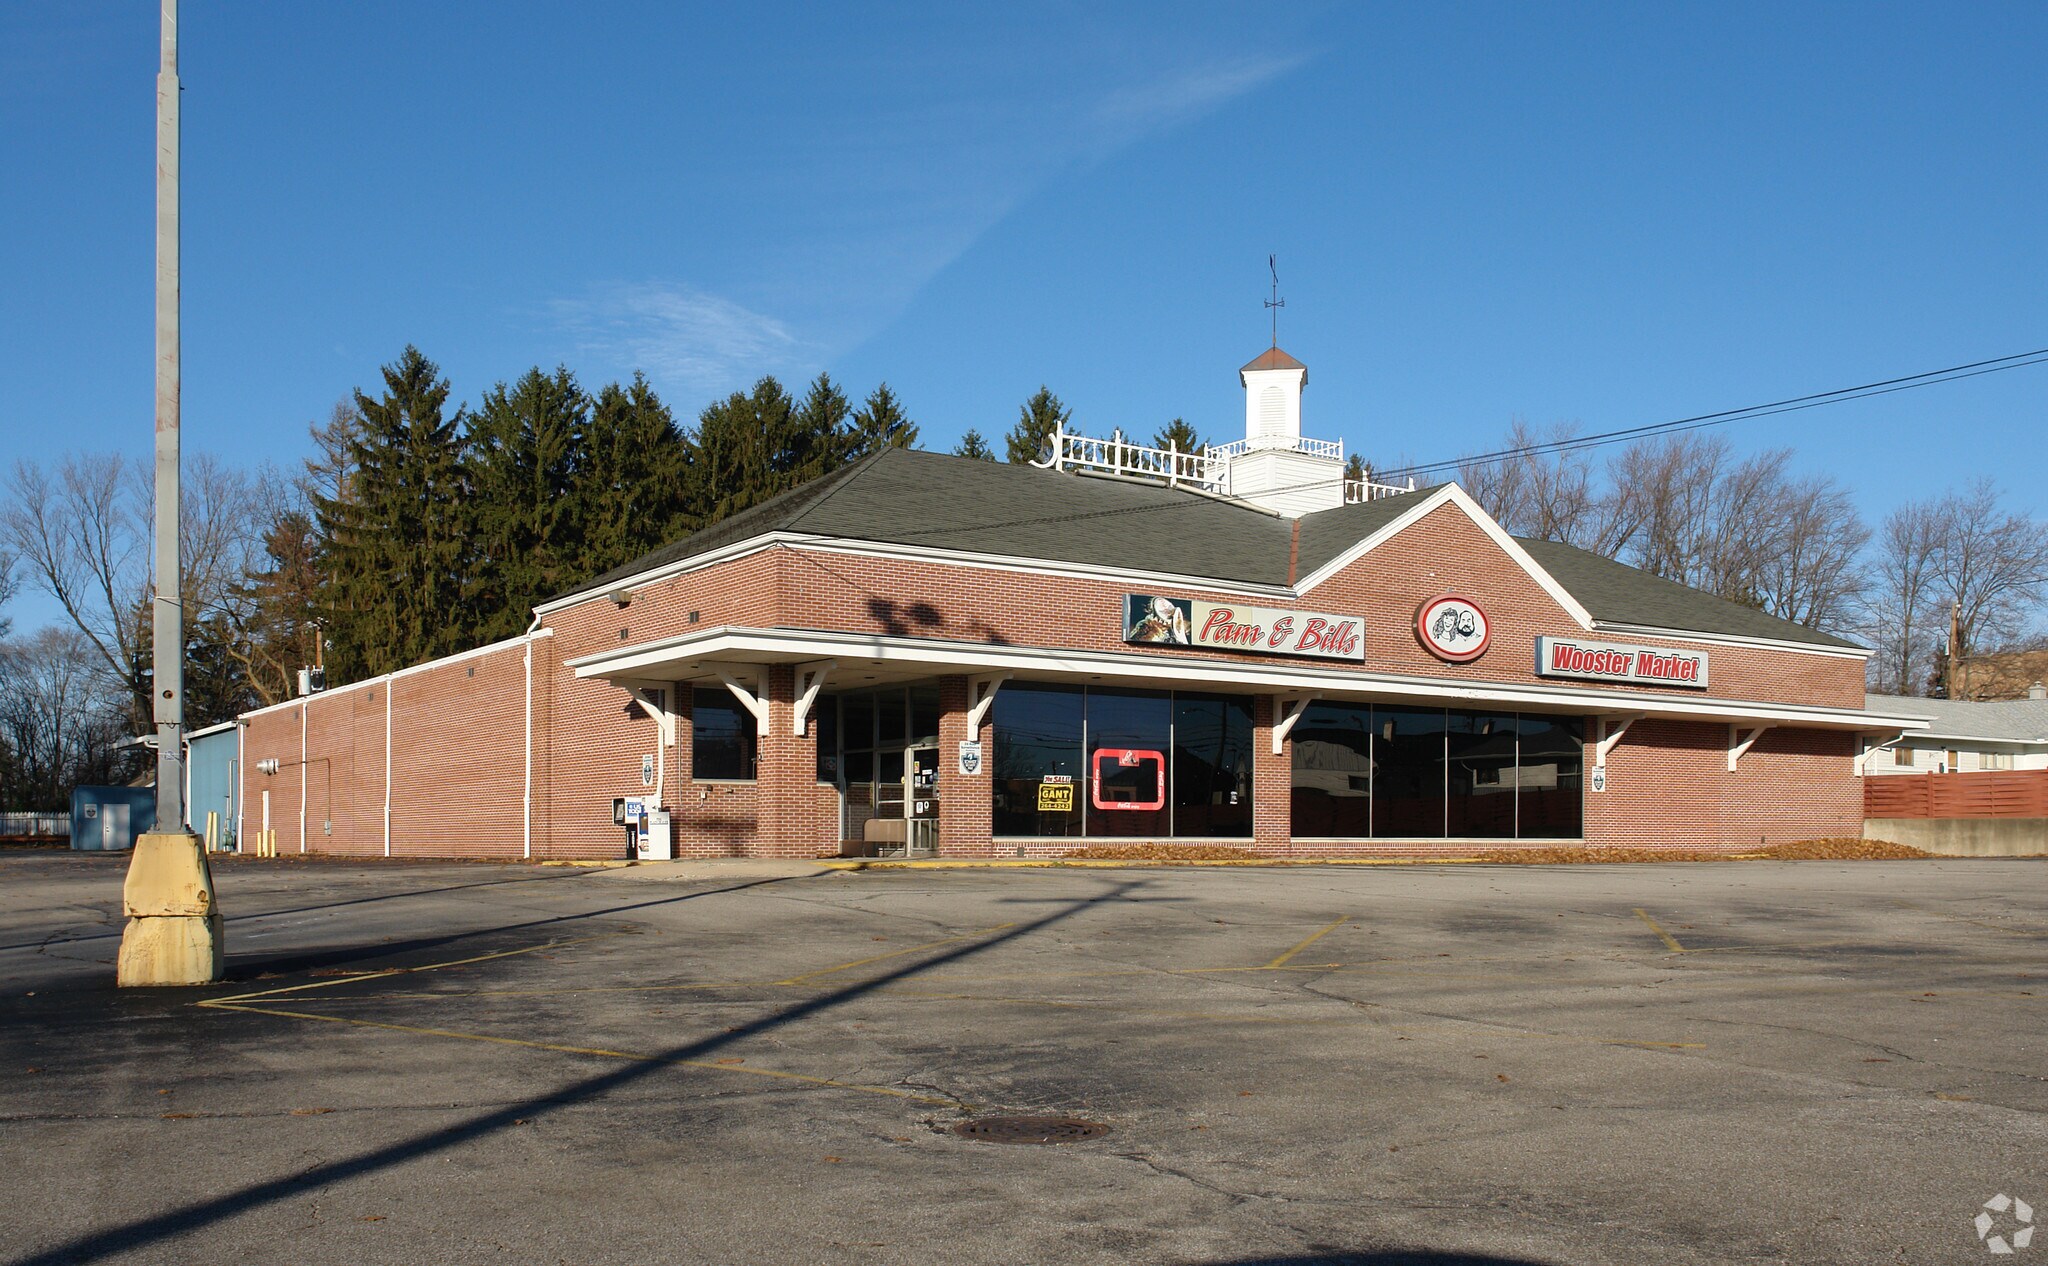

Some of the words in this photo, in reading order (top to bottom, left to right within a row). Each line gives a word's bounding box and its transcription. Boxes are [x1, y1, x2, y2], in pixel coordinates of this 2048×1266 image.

[1199, 608, 1265, 646] Pam
[1268, 616, 1294, 648] &
[1552, 643, 1634, 676] Wooster
[1635, 651, 1700, 682] Market
[1042, 789, 1069, 799] GANT
